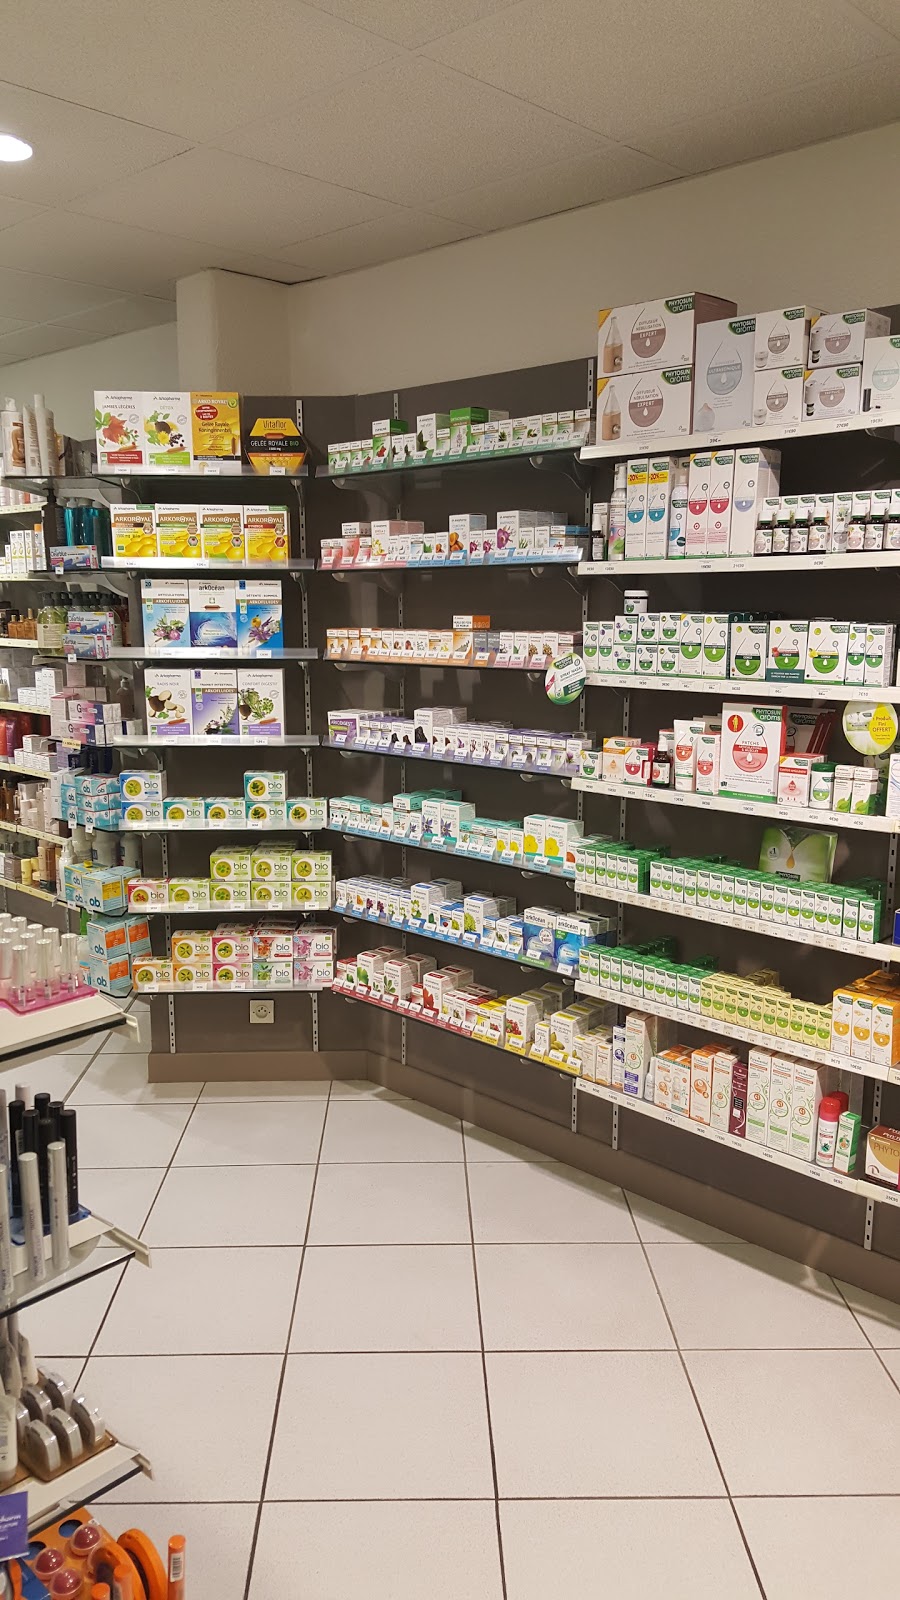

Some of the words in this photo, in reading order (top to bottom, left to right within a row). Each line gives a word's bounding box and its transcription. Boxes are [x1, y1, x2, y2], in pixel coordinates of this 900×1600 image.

[668, 297, 692, 306] PHYTOSUN
[665, 369, 690, 377] PHYTOSUN
[263, 420, 286, 428] Vitaflor
[144, 781, 158, 789] bio
[187, 809, 201, 817] bio
[228, 808, 242, 816] bio
[310, 808, 324, 816] bio
[150, 891, 165, 900] bio
[192, 890, 207, 899] bio
[233, 889, 247, 897] bio
[274, 889, 288, 897] bio
[314, 889, 328, 897] bio
[276, 943, 290, 951] bio
[156, 970, 170, 978] bio
